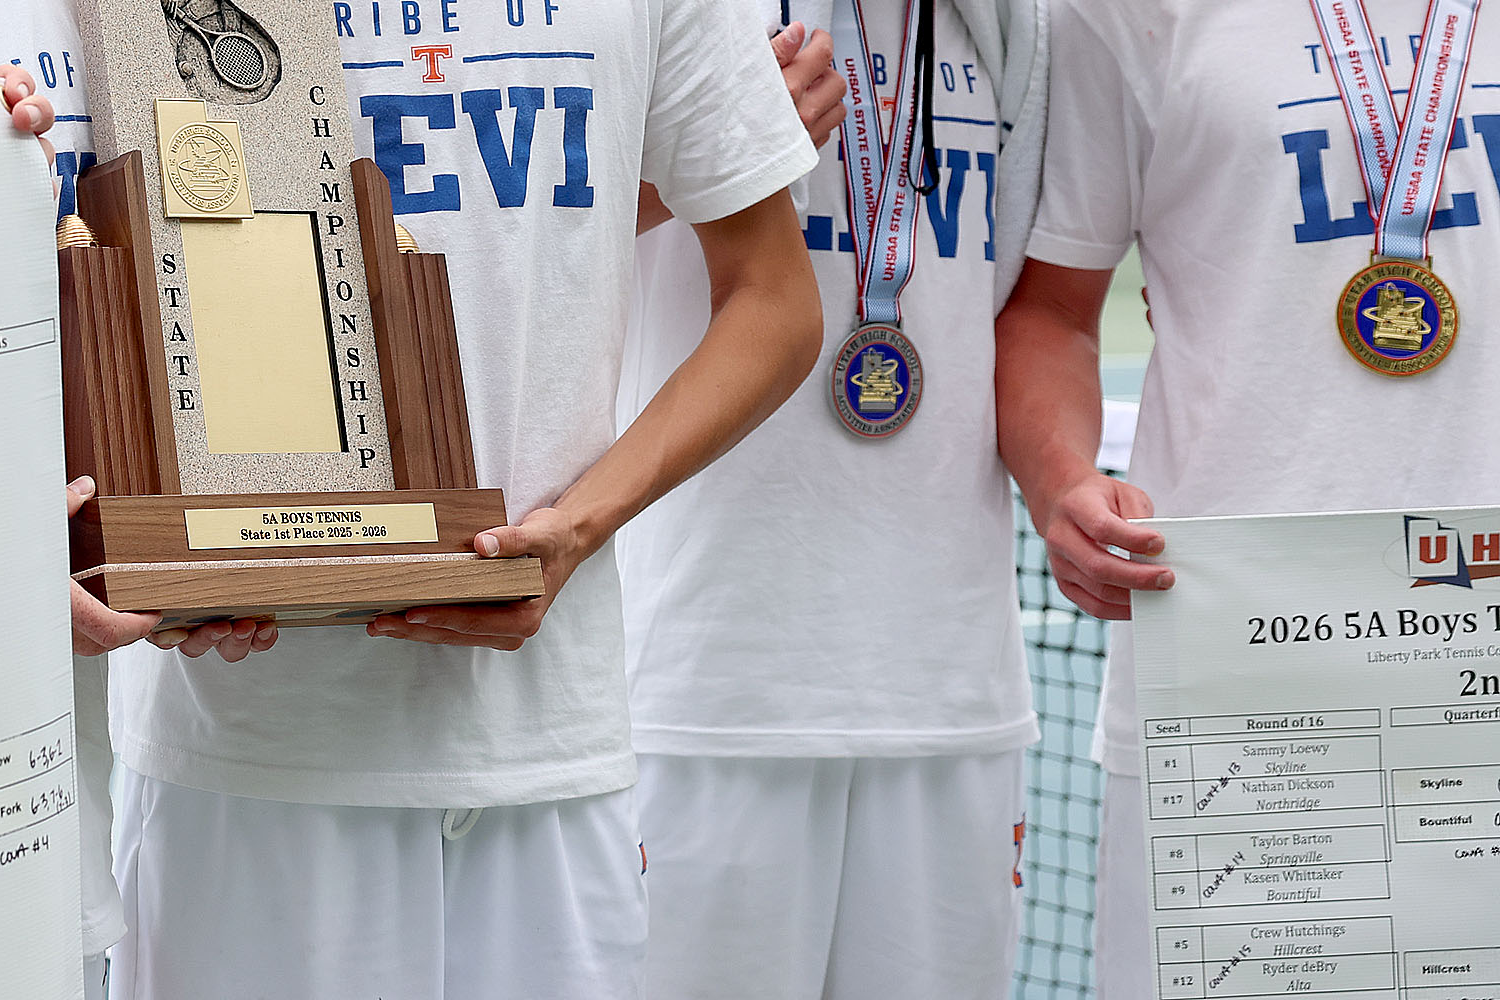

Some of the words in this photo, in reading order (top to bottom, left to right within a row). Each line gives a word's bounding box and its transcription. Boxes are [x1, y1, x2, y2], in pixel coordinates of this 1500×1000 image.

[411, 43, 453, 84] T
[1347, 50, 1371, 90] STATE
[844, 57, 863, 106] UHSAA
[940, 62, 978, 94] OF
[853, 109, 870, 152] STATE
[359, 85, 595, 216] EVI
[1402, 169, 1424, 216] UHSAA
[1414, 127, 1436, 168] STATE
[889, 191, 906, 233] STATE
[883, 236, 899, 282] UHSAA
[308, 84, 377, 470] CHAMPIONSHIP
[161, 252, 197, 411] STATE
[262, 512, 279, 525] 5A
[280, 511, 314, 525] BOYS
[316, 510, 362, 524] TENNIS
[240, 527, 271, 541] State
[274, 527, 291, 540] 1st
[293, 526, 325, 539] Place
[327, 526, 353, 538] 2025
[361, 525, 387, 538] 2026
[1248, 613, 1334, 645] 2026
[1344, 610, 1388, 641] 5A
[1397, 608, 1478, 642] Boys
[1367, 649, 1411, 664] Liberty
[1413, 647, 1442, 662] Park
[1444, 645, 1485, 660] Tennis
[1156, 722, 1181, 734] Seed
[1247, 718, 1288, 731] Round
[1291, 717, 1306, 728] of
[1308, 716, 1324, 728] 16
[1242, 744, 1287, 758] Sammy
[1290, 742, 1331, 756] Loewy
[1164, 758, 1177, 769] #1
[1264, 761, 1308, 777] Skyline
[1242, 780, 1286, 794] Nathan
[1287, 778, 1336, 791] Dickson
[1420, 778, 1464, 790] Skyline
[1163, 794, 1184, 805] #17
[1256, 796, 1321, 812] Northridge
[0, 802, 23, 818] Fork
[1419, 814, 1474, 828] Bountiful
[1250, 834, 1290, 848] Taylor
[1292, 832, 1333, 846] Barton
[1169, 849, 1184, 860] #8
[1259, 850, 1324, 868] Springville
[1243, 871, 1280, 885] Kasen
[1281, 867, 1345, 882] Whittaker
[1171, 885, 1185, 896] #9
[1266, 886, 1322, 903] Bountiful
[1250, 925, 1282, 940] Crew
[1284, 923, 1347, 939] Hutchings
[1174, 938, 1189, 950] #5
[1273, 941, 1324, 957] Hillcrest
[1262, 962, 1300, 976] Ryder
[1301, 960, 1338, 975] deBry
[1422, 962, 1472, 975] Hillcrest
[1172, 975, 1194, 986] #12
[1286, 978, 1312, 992] Alta
